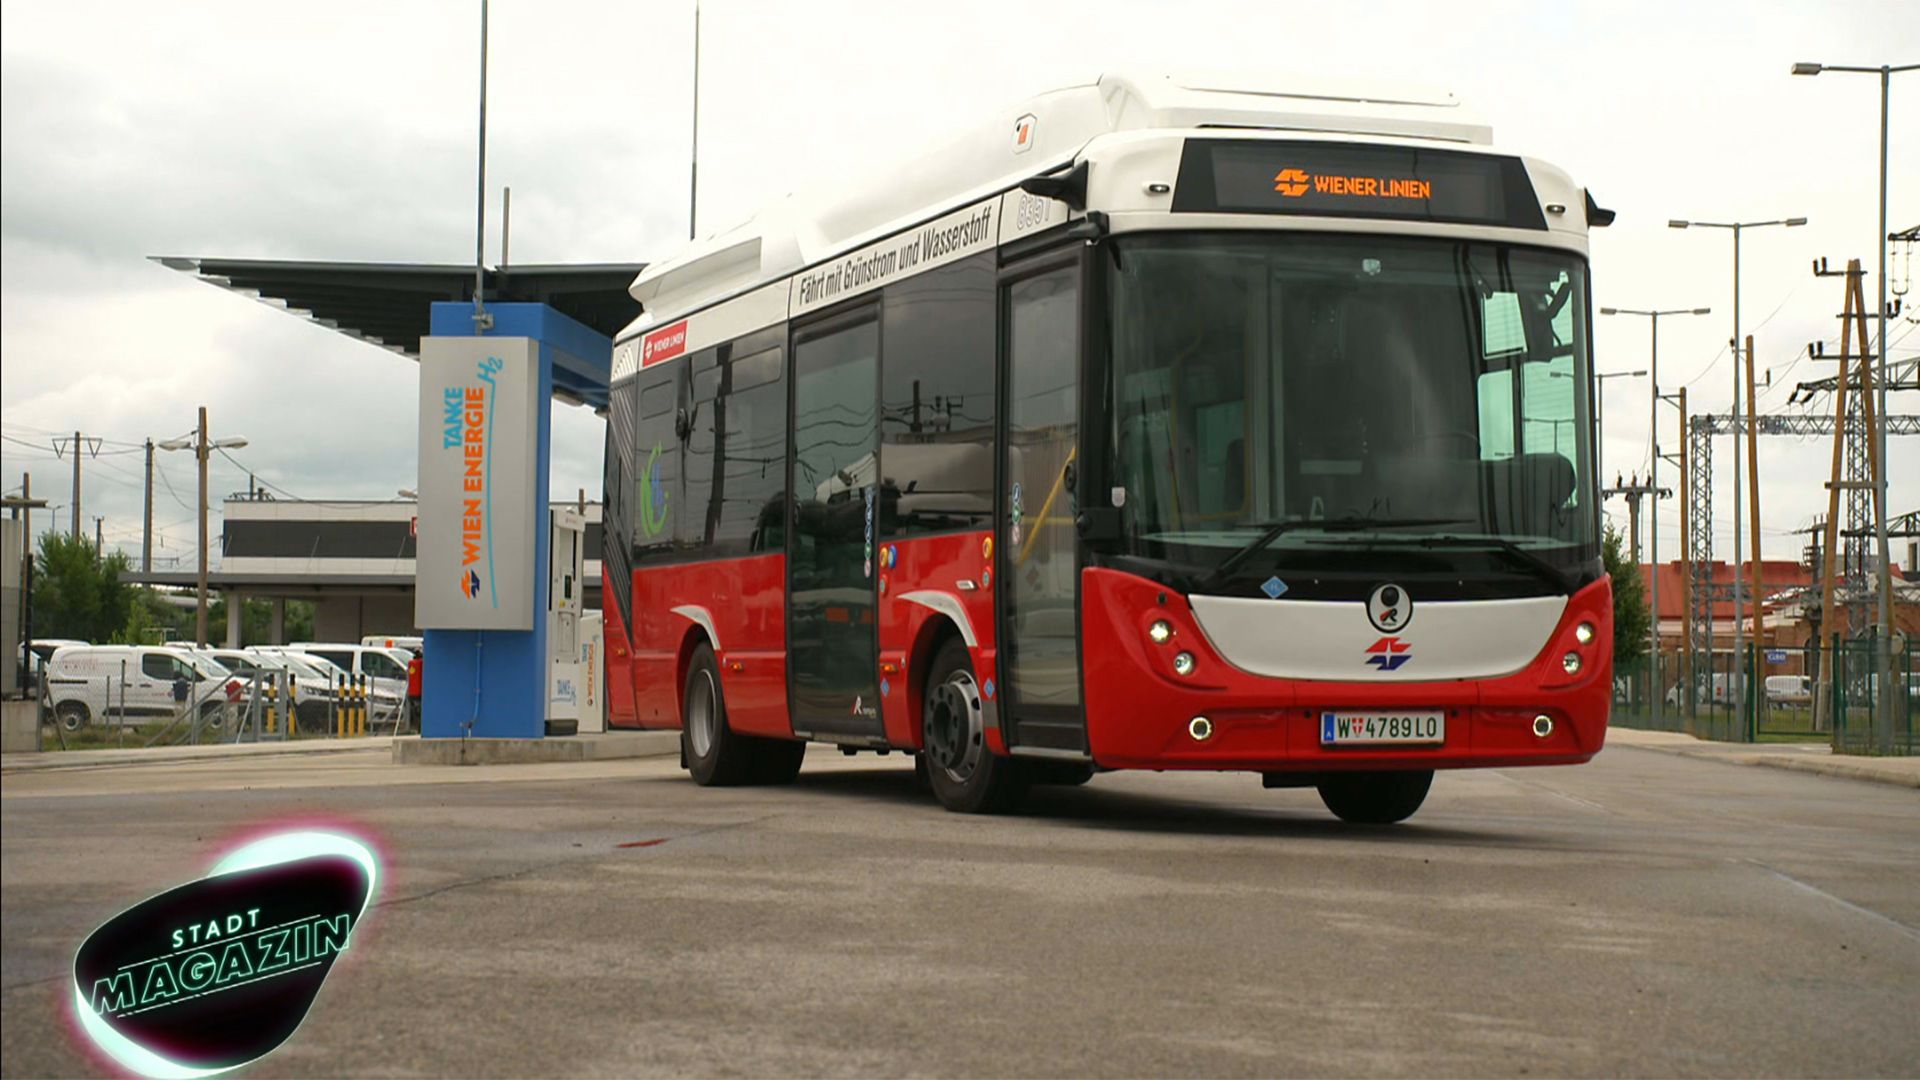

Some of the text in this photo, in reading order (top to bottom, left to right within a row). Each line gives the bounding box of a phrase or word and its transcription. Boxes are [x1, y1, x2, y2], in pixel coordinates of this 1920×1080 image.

[1314, 175, 1431, 199] WIENER LINIEN
[799, 206, 992, 306] Fährt mit Grünstrom und Wasserstoff
[444, 386, 463, 449] TANKE
[462, 386, 485, 566] WIEN ENERGIE
[1337, 717, 1351, 738] W
